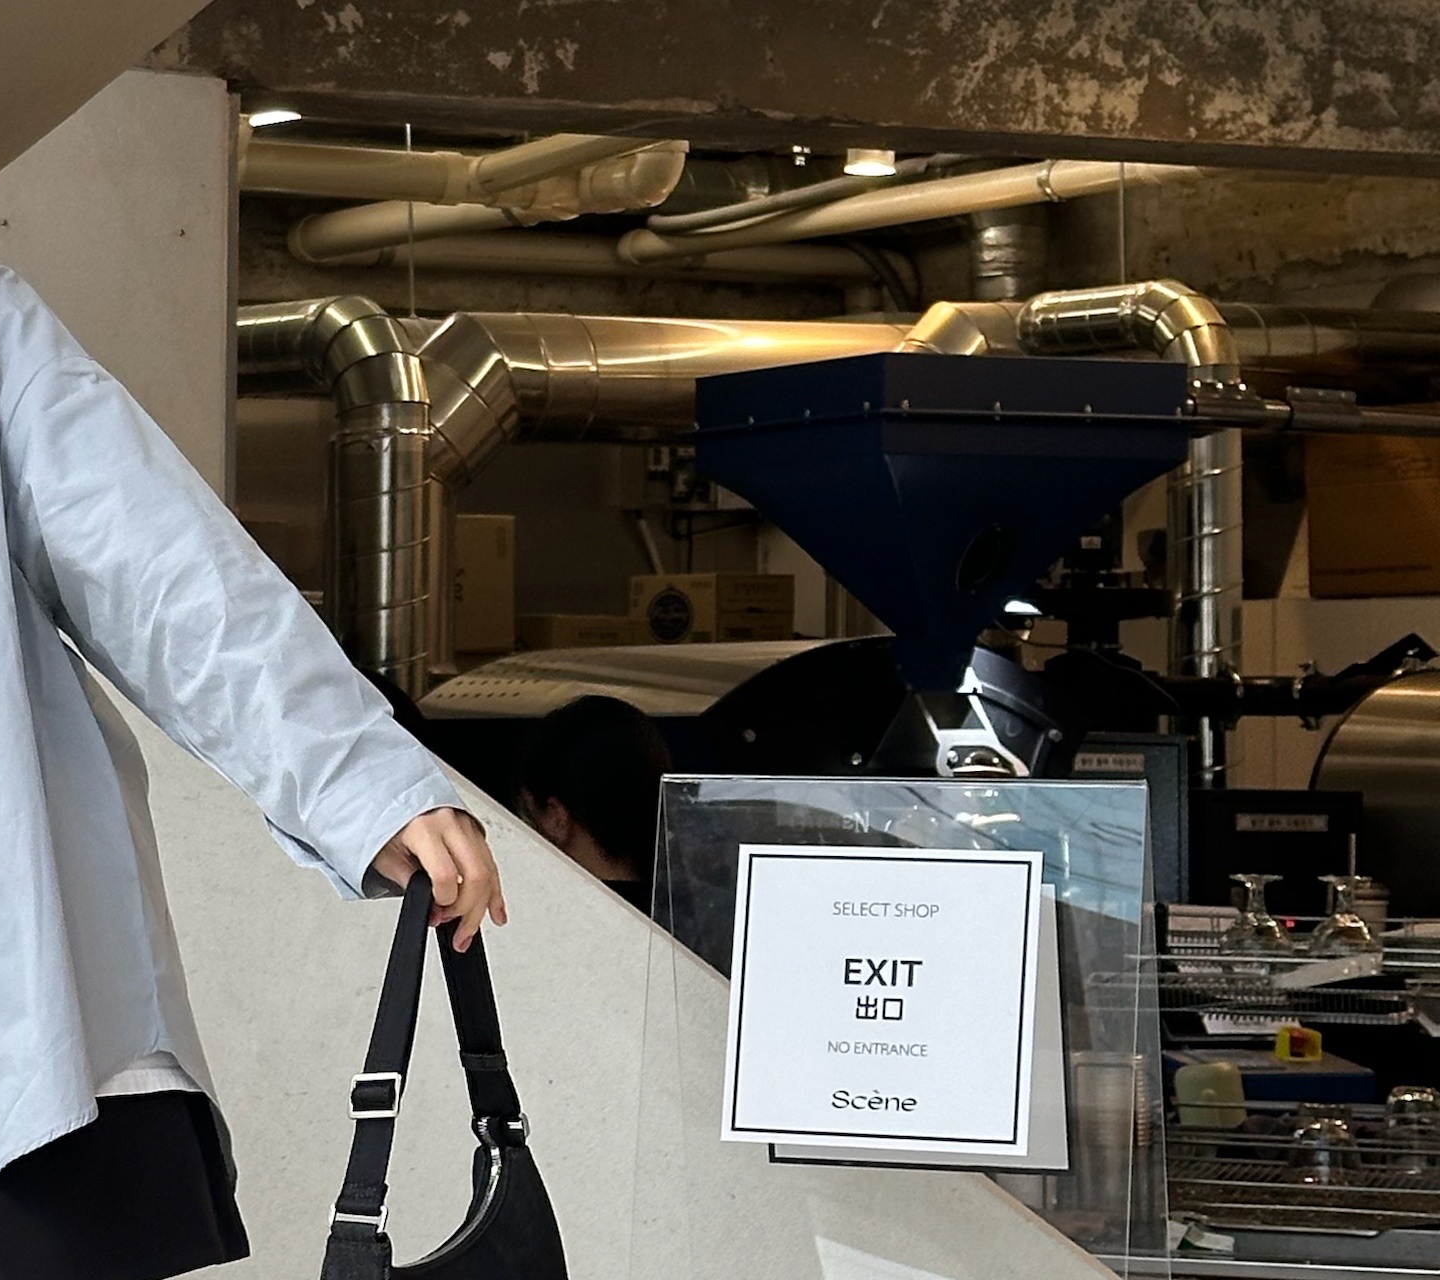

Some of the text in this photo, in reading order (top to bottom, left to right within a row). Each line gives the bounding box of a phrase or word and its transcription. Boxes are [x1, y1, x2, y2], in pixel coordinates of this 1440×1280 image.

[832, 901, 940, 919] SELECT SHOP
[843, 957, 923, 987] EXIT
[855, 995, 904, 1021] 出口
[827, 1040, 929, 1058] NO ENTRANCE
[831, 1089, 918, 1113] Scène
